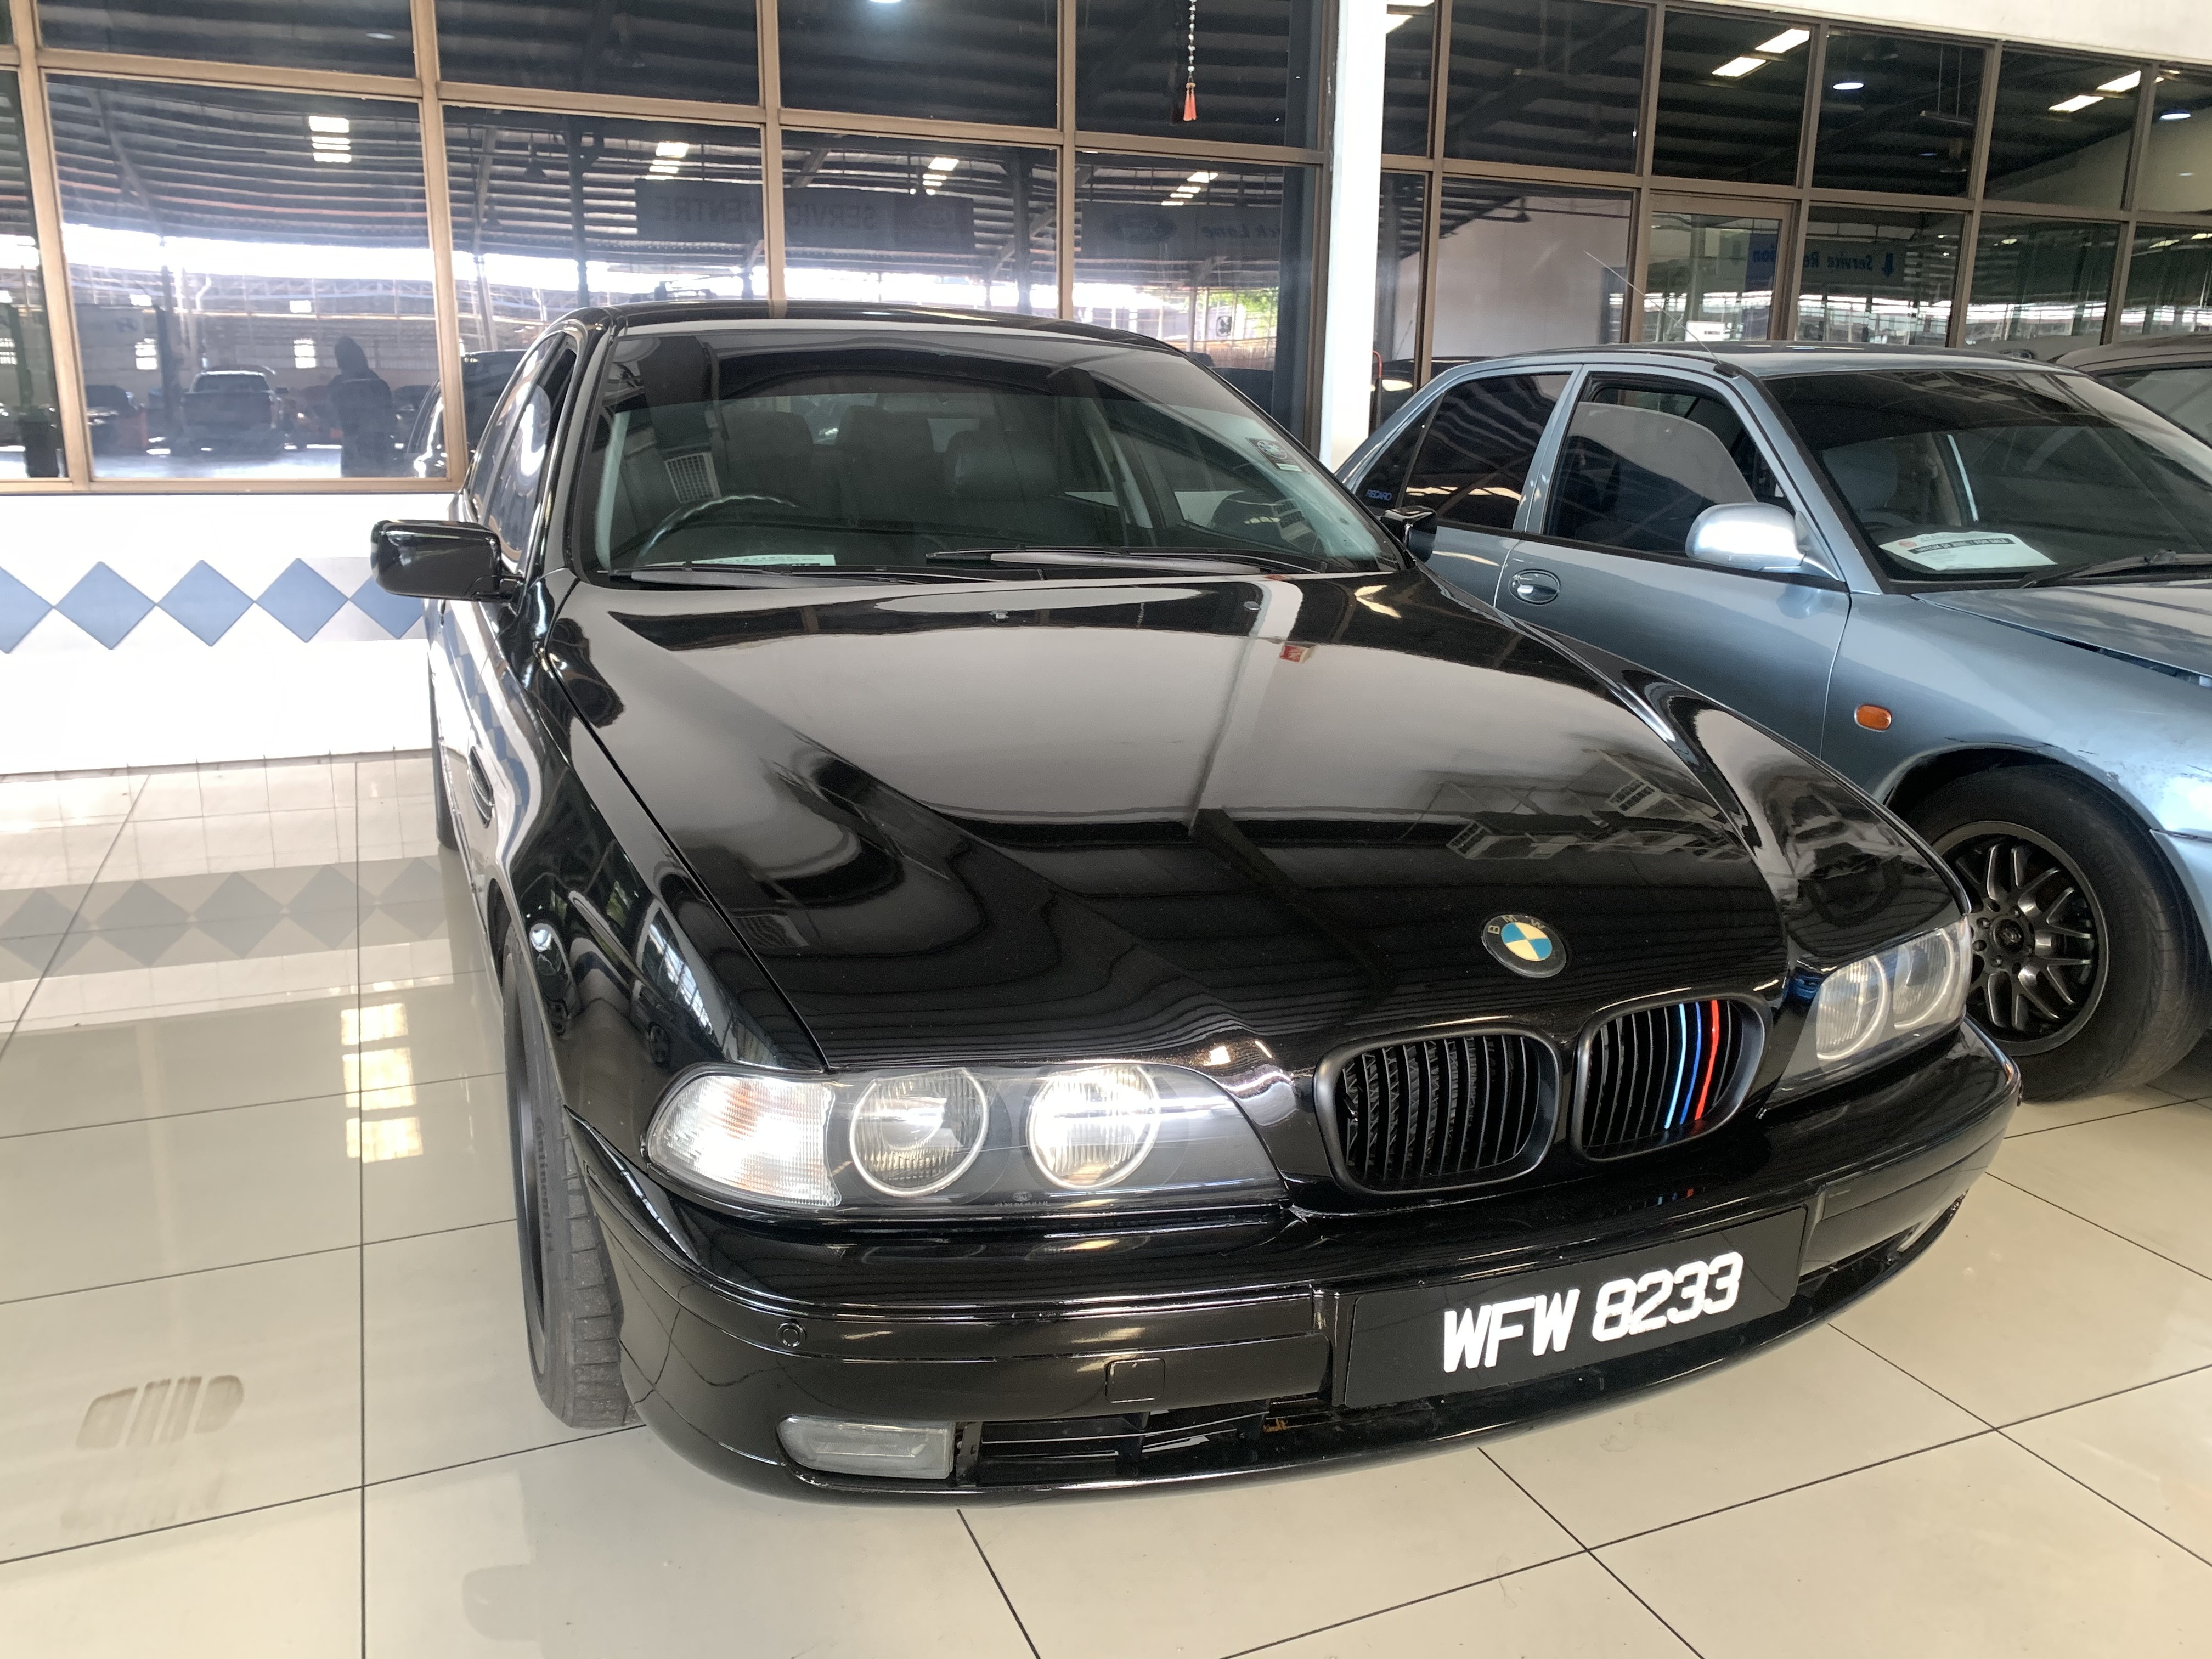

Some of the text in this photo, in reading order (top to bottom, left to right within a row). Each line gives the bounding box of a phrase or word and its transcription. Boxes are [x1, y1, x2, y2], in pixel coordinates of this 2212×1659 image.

[1365, 489, 1392, 501] RECARO
[1487, 914, 1545, 935] BMW
[1443, 1251, 1744, 1373] WFW 8233
